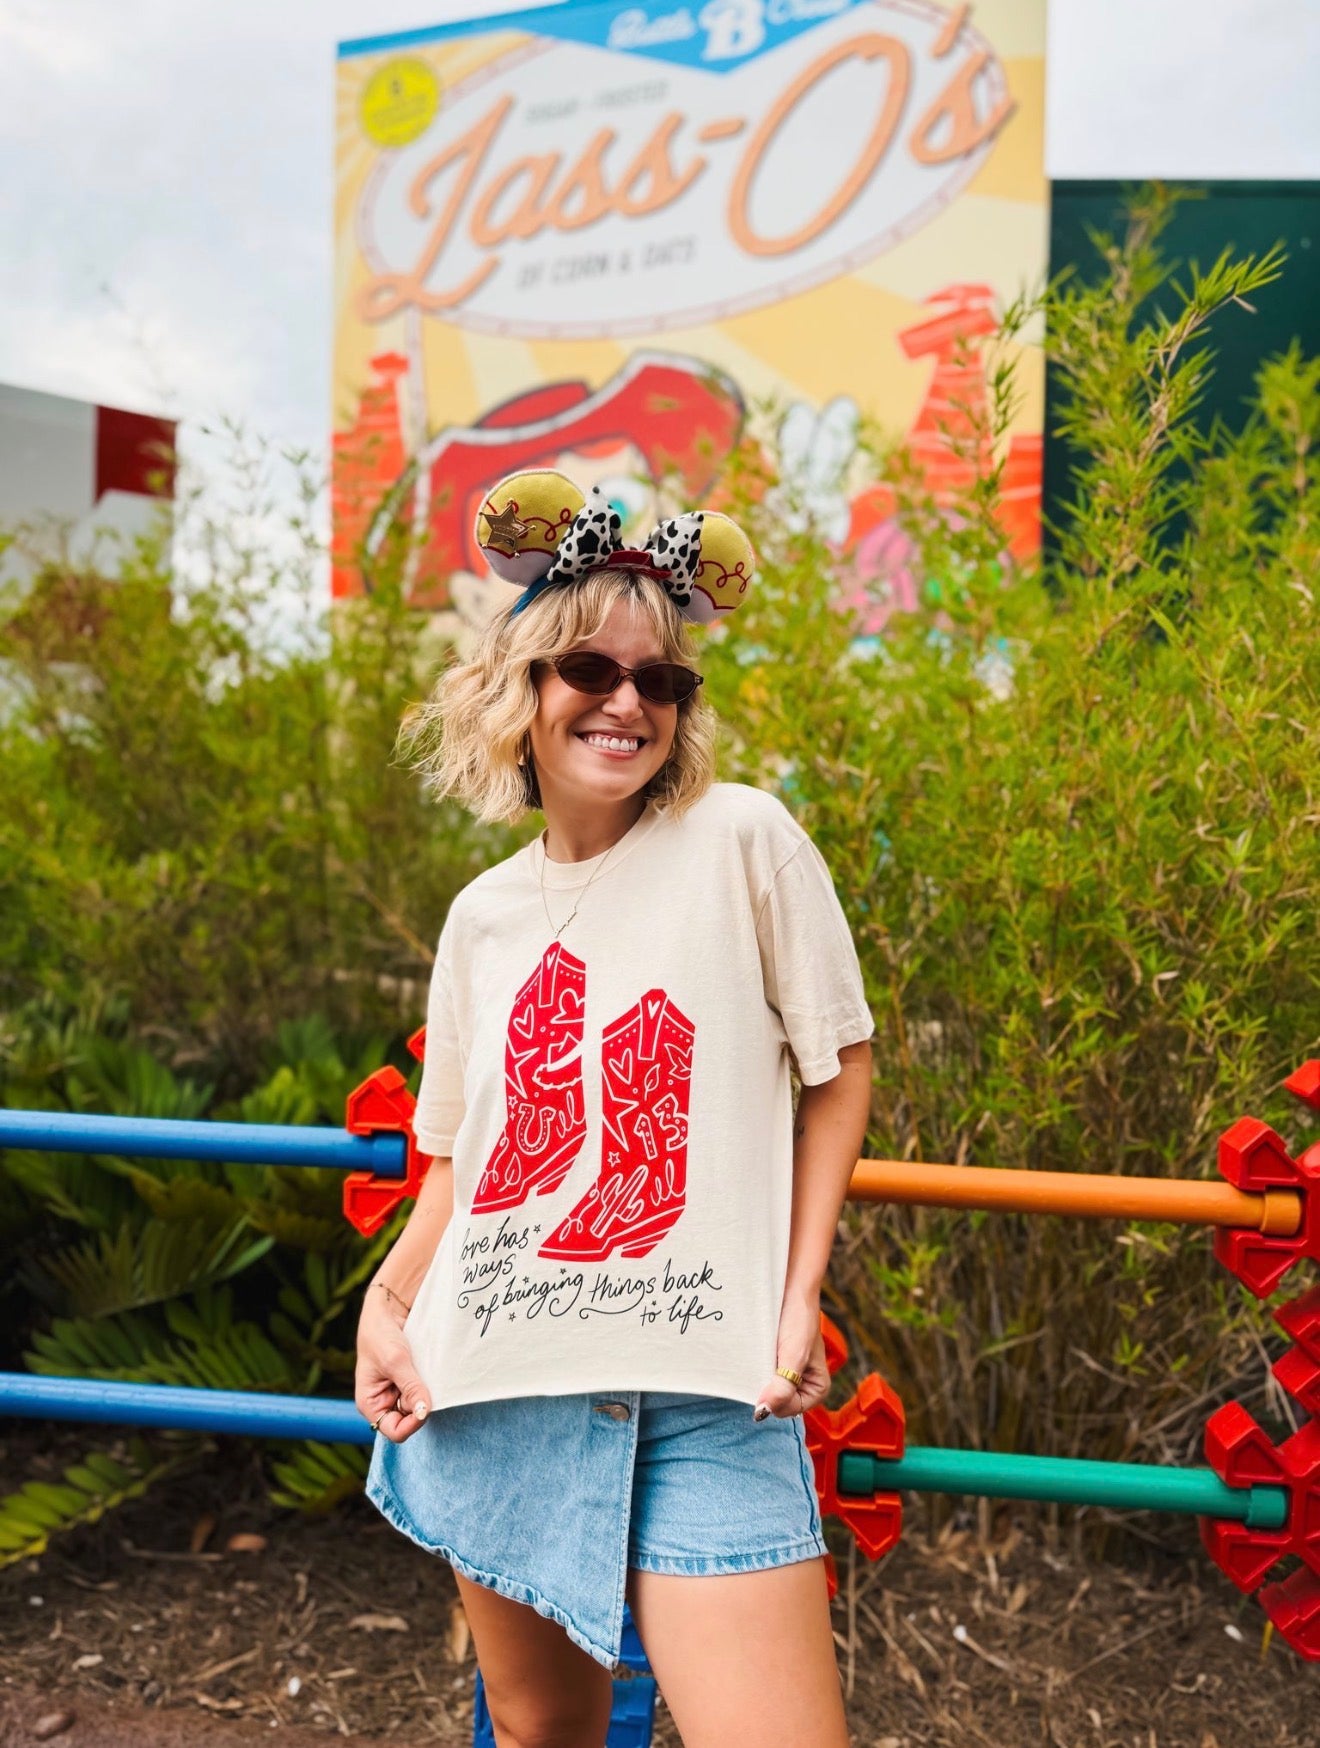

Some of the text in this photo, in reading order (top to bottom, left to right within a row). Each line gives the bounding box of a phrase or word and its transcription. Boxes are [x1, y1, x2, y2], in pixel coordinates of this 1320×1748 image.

[633, 1092, 689, 1160] 13
[493, 1215, 530, 1254] has
[457, 1253, 517, 1309] ways
[473, 1257, 723, 1338] of bringing things back
[639, 1293, 723, 1335] to life
